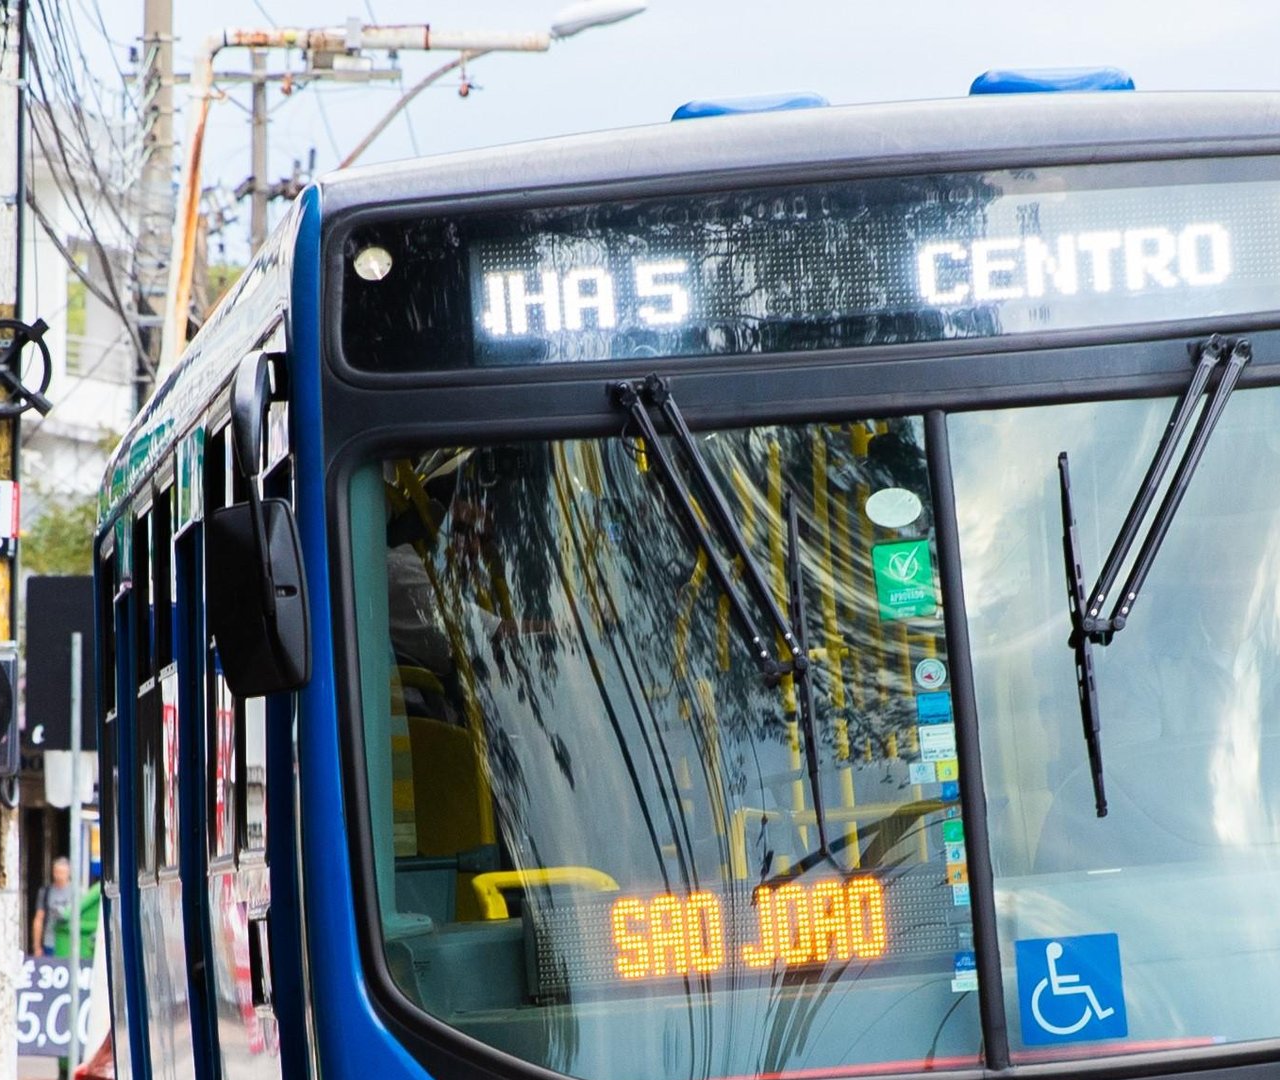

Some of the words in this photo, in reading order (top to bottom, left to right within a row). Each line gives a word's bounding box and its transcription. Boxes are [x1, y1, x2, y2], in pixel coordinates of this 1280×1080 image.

[634, 259, 689, 325] 5
[920, 221, 1230, 303] CENTRO
[611, 890, 724, 978] SAO
[742, 874, 886, 968] JOAO
[37, 964, 70, 989] 30
